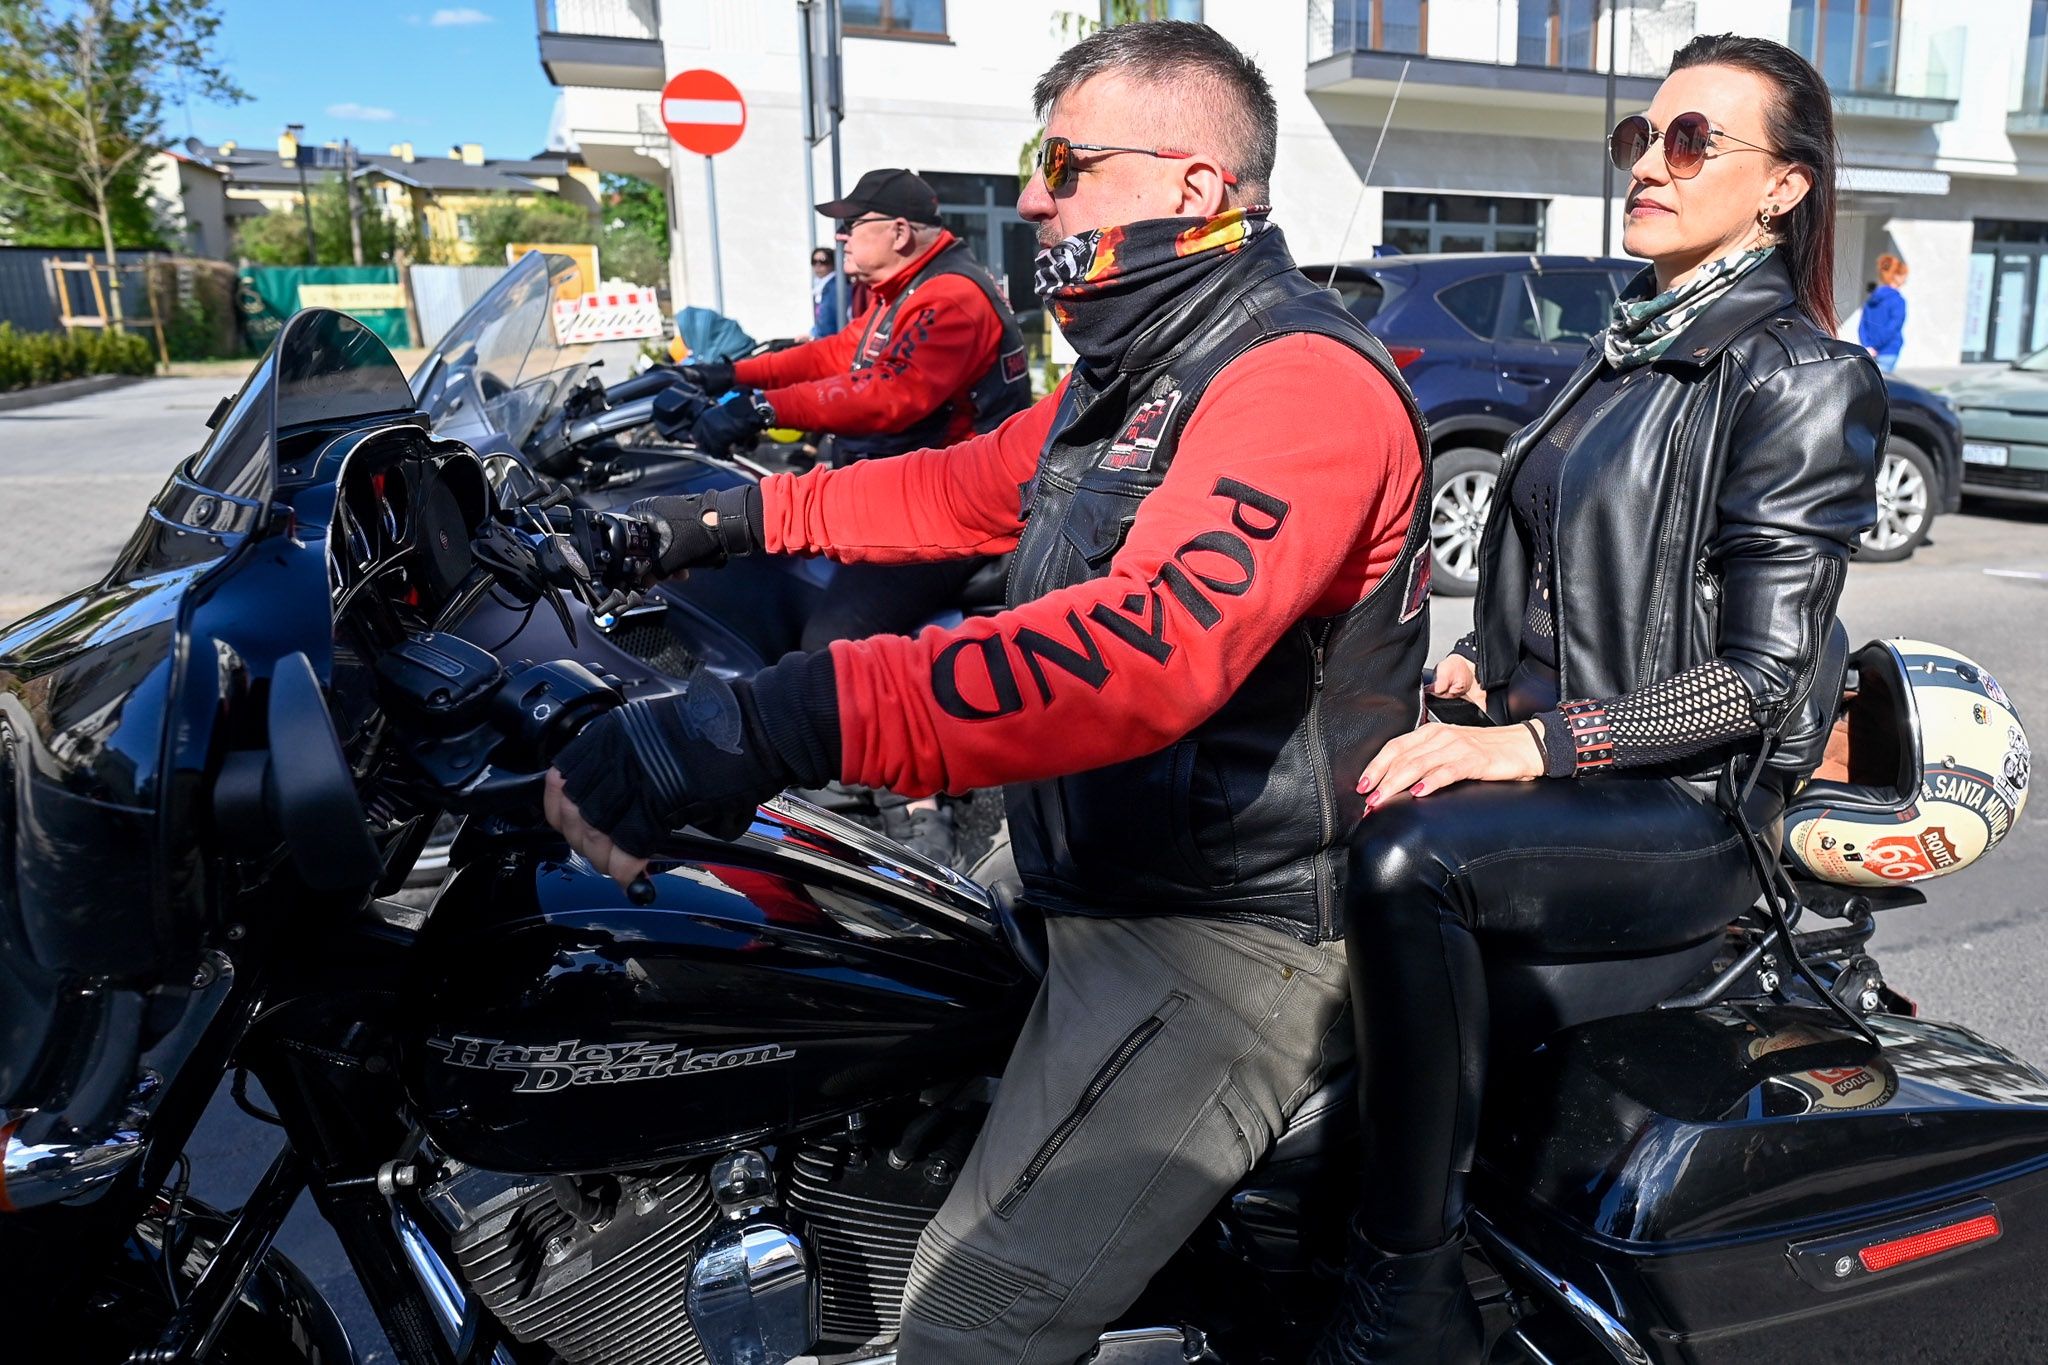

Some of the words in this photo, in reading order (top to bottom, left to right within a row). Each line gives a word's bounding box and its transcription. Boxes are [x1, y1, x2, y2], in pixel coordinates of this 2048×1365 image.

[932, 476, 1290, 721] POLAND
[1935, 774, 1986, 810] SANTA
[1980, 794, 2009, 846] MONICA
[1872, 843, 1926, 878] 66
[1924, 832, 1954, 868] ROUTE
[493, 1042, 798, 1093] Davidson
